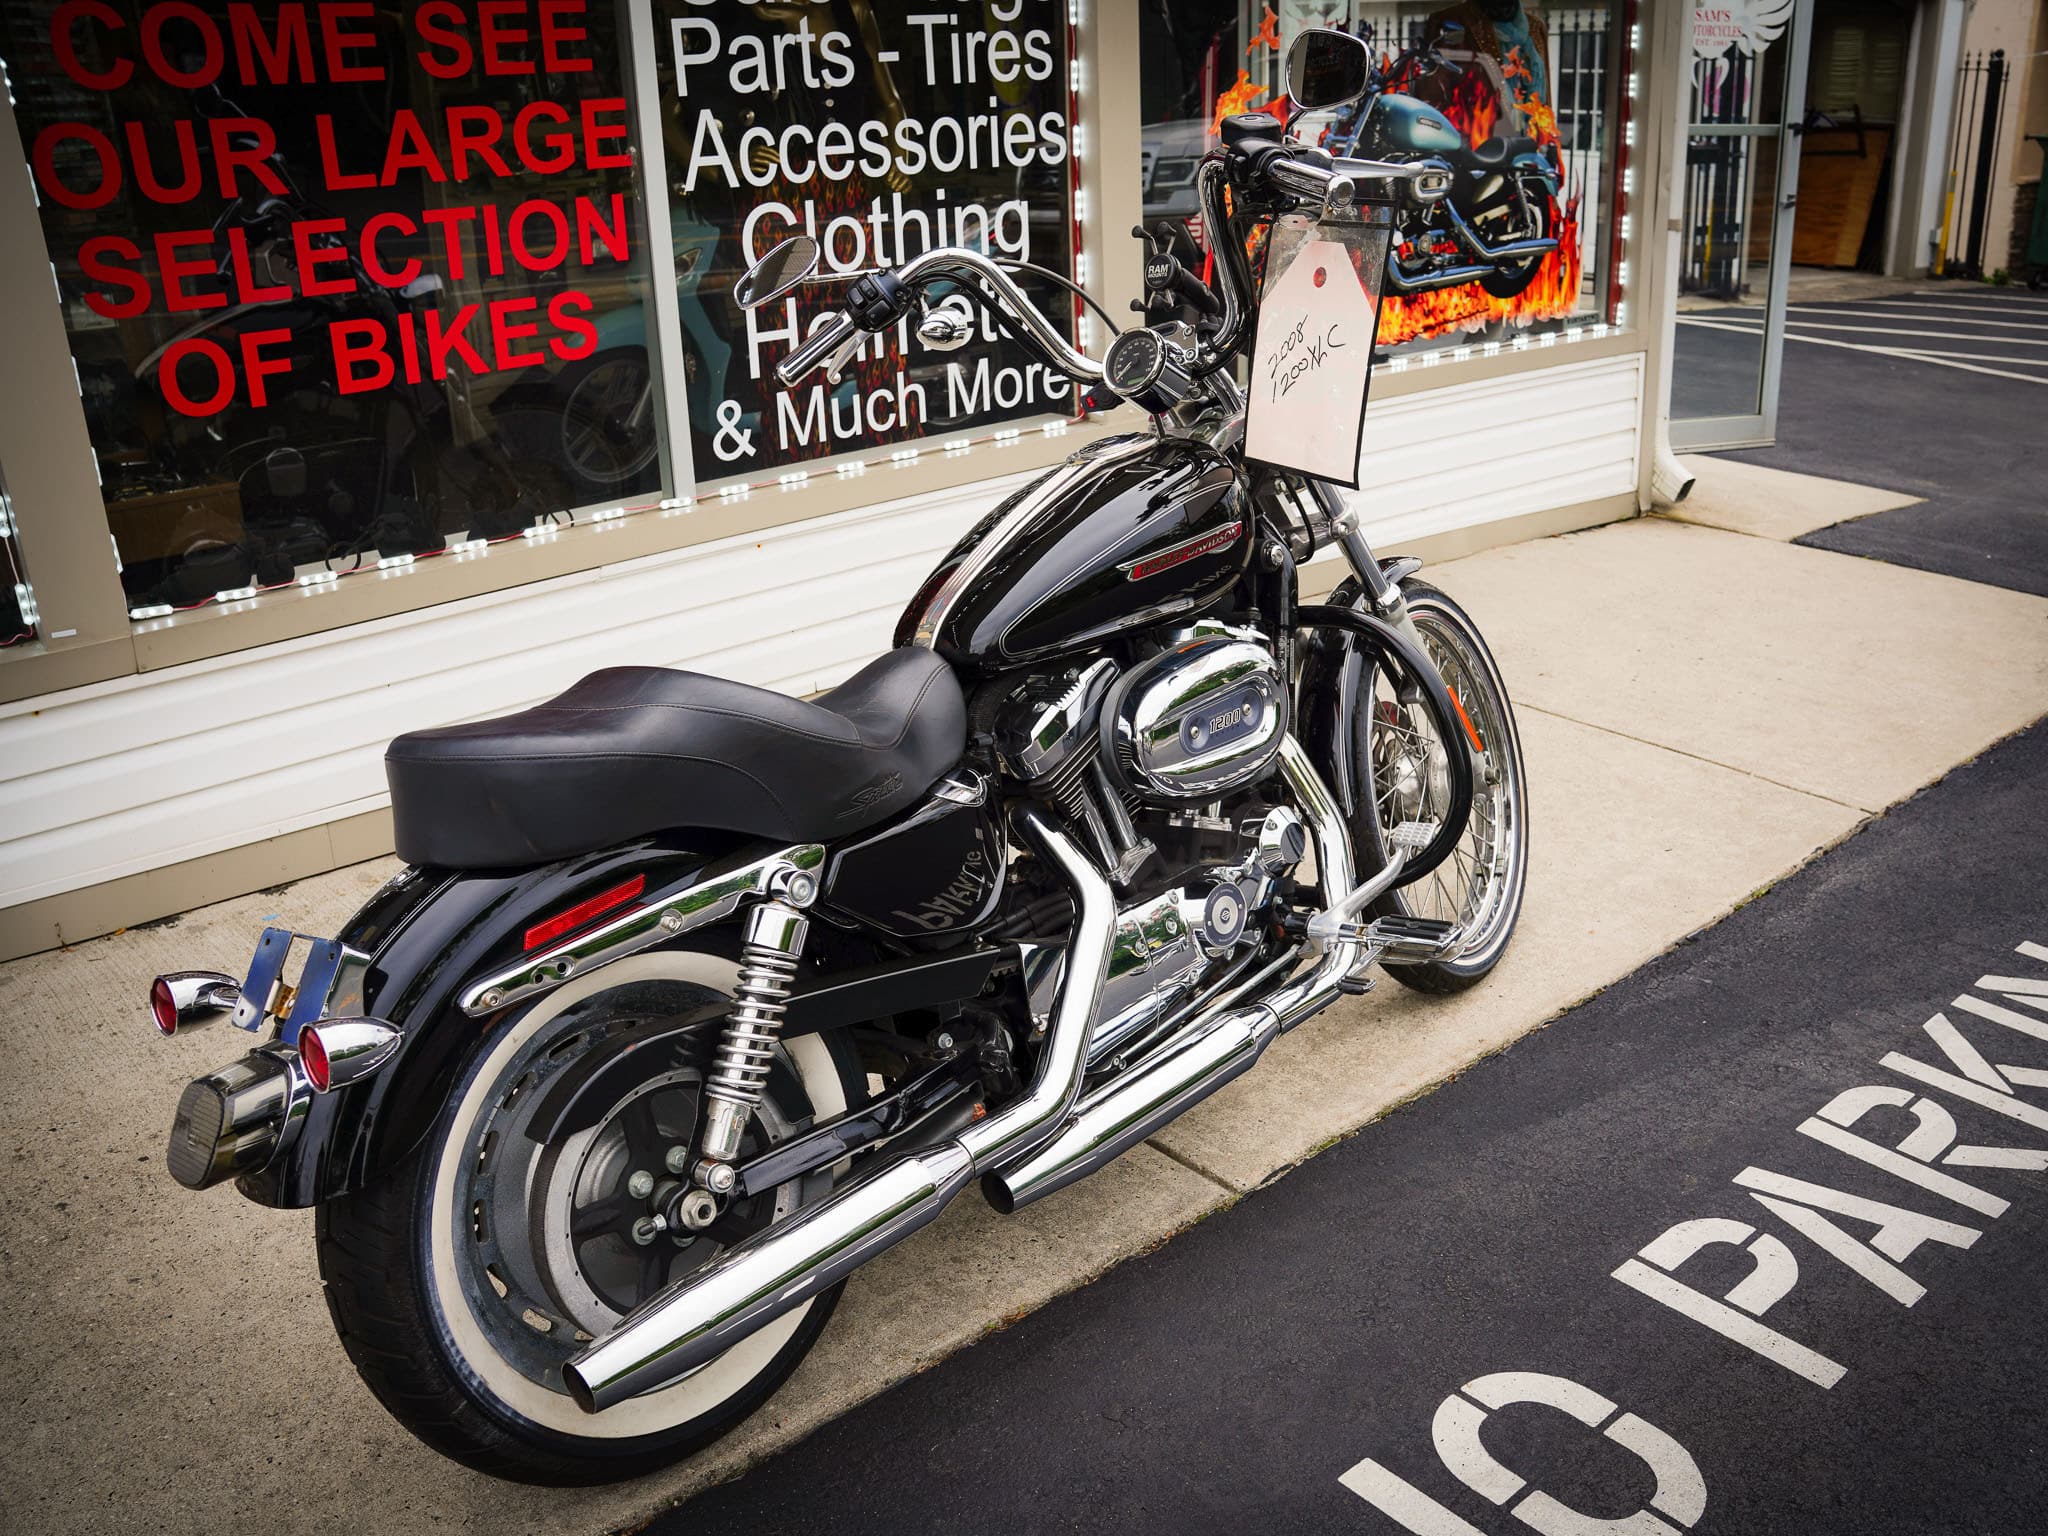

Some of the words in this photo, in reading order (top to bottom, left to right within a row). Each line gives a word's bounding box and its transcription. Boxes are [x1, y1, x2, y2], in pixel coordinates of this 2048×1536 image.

[50, 0, 386, 91] COME
[414, 0, 593, 79] SEE
[670, 15, 856, 98] Parts
[907, 13, 1053, 86] Tires
[32, 116, 289, 211] OUR
[315, 97, 633, 191] LARGE
[685, 96, 1067, 192] Accessories
[77, 192, 629, 320] SELECTION
[741, 188, 1031, 275] Clothing
[1148, 264, 1170, 274] RAM
[158, 327, 294, 417] OF
[329, 290, 598, 395] BIKES
[1267, 314, 1308, 379] 2008
[712, 399, 757, 462] &
[777, 372, 927, 450] Much
[947, 357, 1070, 418] More
[1209, 707, 1241, 735] 1200
[1338, 1371, 1708, 1536] O
